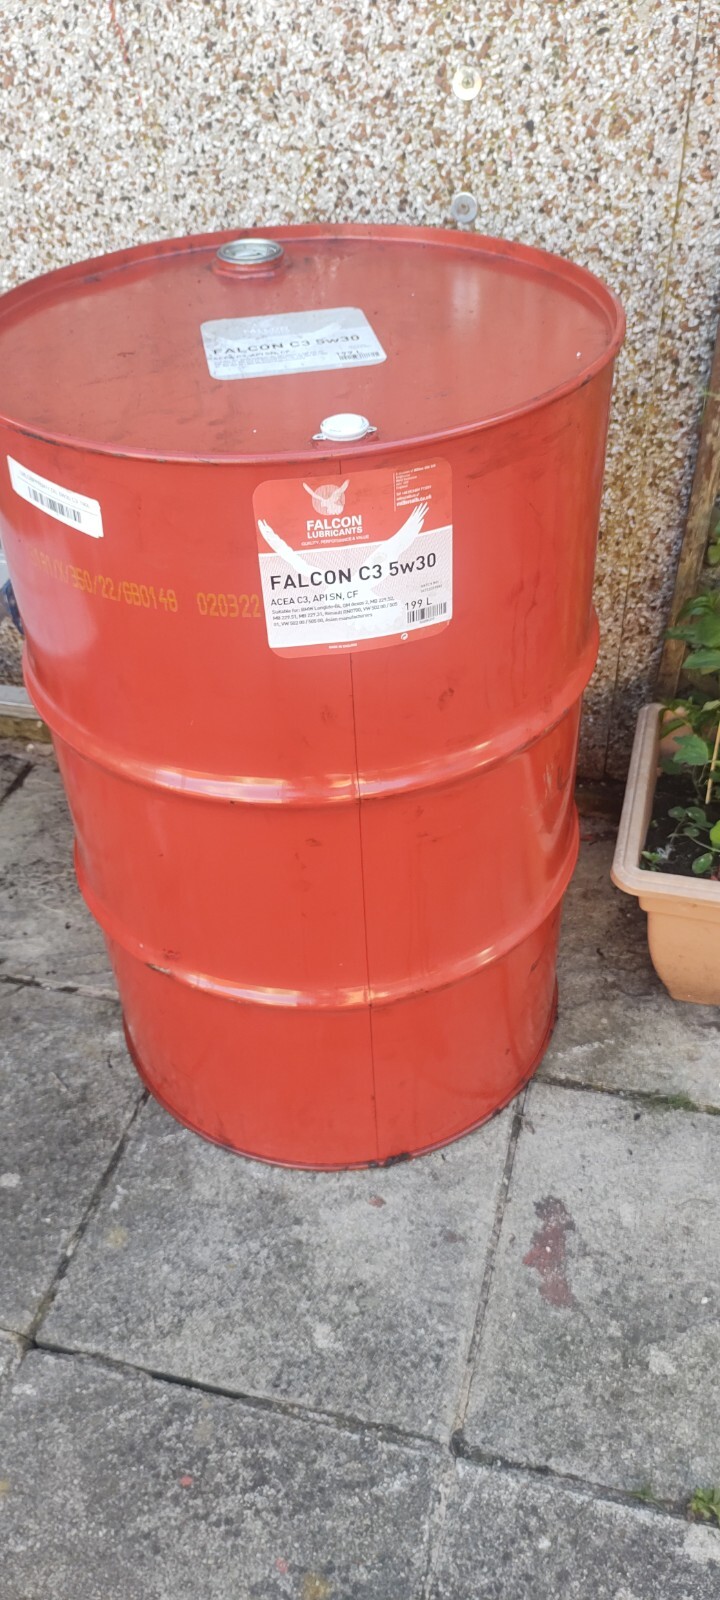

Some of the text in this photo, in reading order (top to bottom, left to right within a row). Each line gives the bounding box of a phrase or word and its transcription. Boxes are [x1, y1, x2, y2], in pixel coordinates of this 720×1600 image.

[213, 342, 284, 355] FALCON
[290, 340, 310, 349] C3
[306, 514, 363, 532] FALCON
[307, 526, 363, 539] LUBRICANTS
[270, 552, 437, 591] FALCON C3 5w30
[196, 592, 261, 618] 020322
[271, 589, 359, 606] ACEA C3, API SN, CF
[404, 596, 433, 611] 199 L
